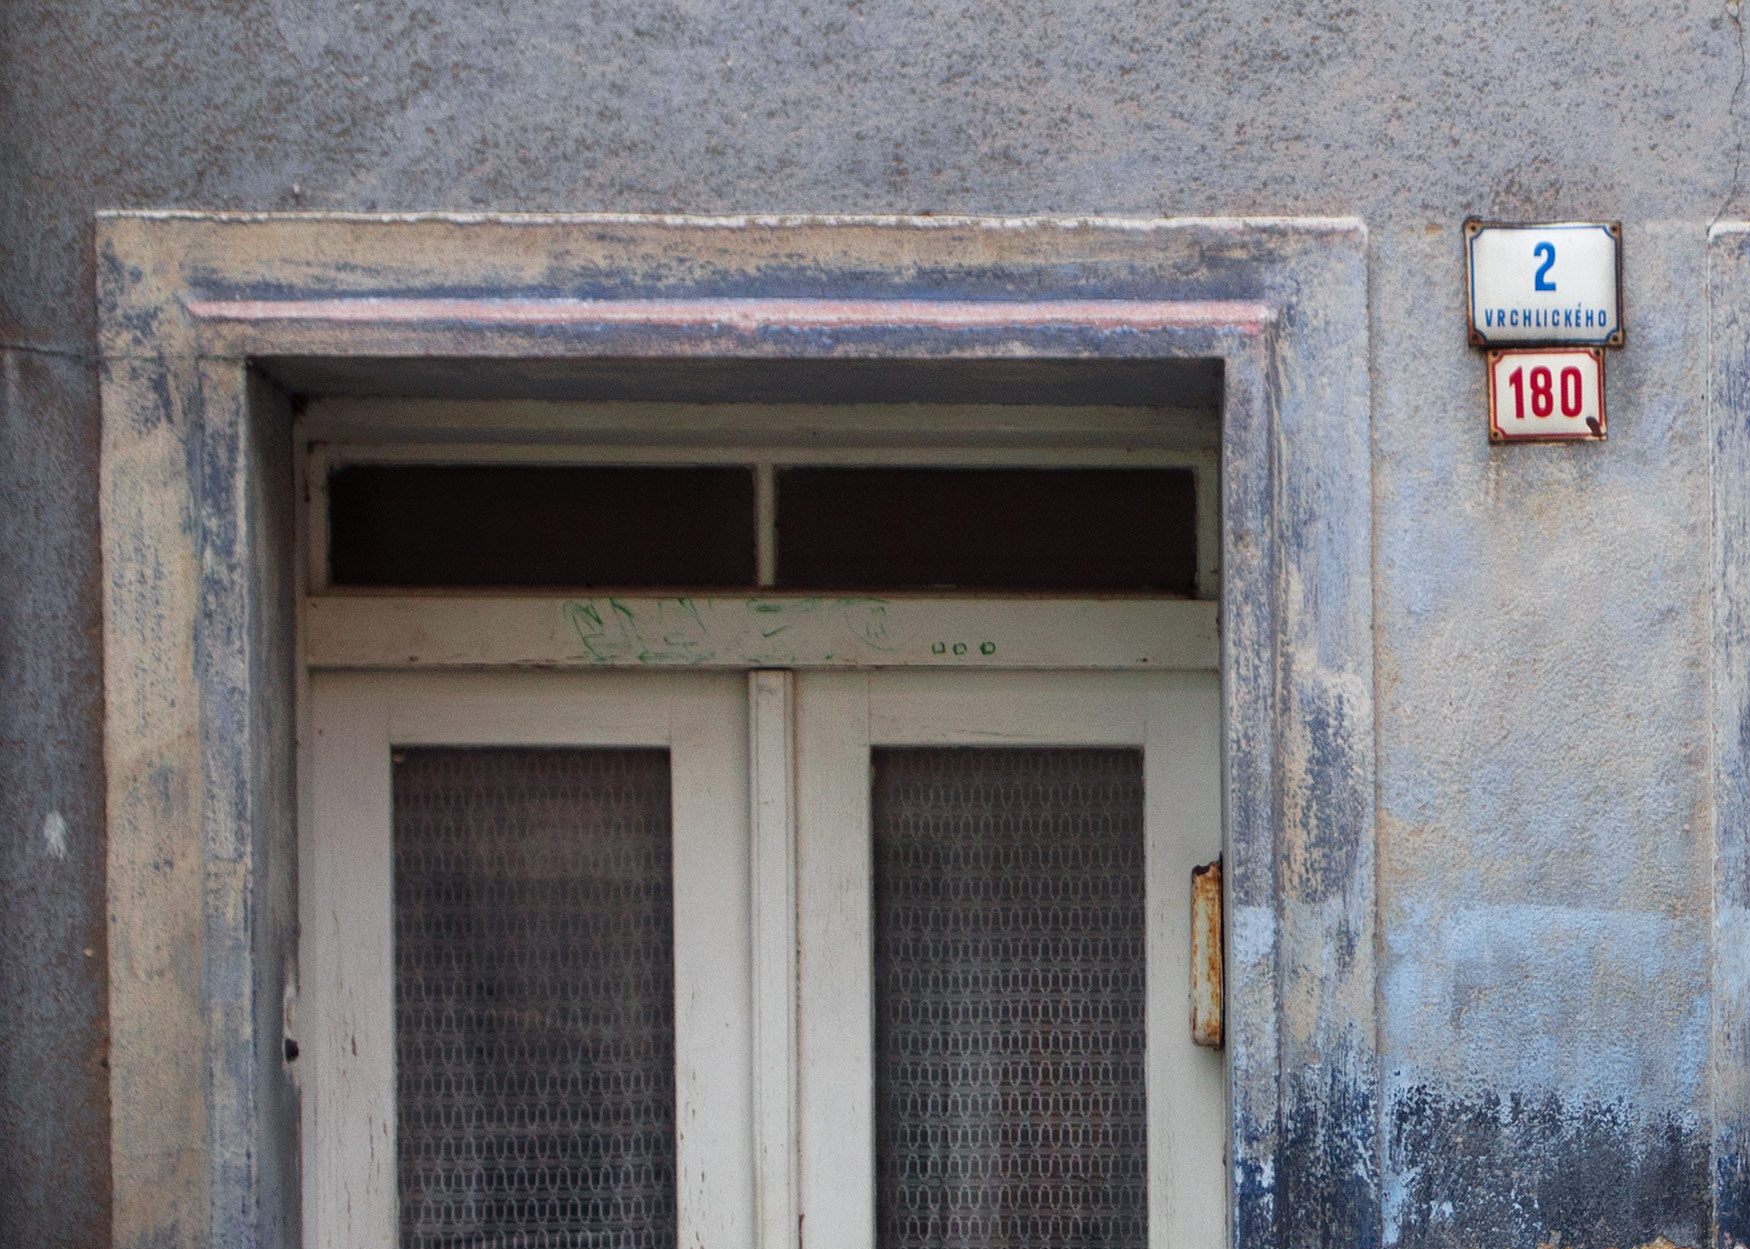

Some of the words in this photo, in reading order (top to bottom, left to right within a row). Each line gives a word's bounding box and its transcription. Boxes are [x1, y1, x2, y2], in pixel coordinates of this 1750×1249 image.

[1533, 241, 1557, 292] 2
[1484, 302, 1607, 328] VRCHLICKÉHO
[1508, 365, 1583, 419] 180
